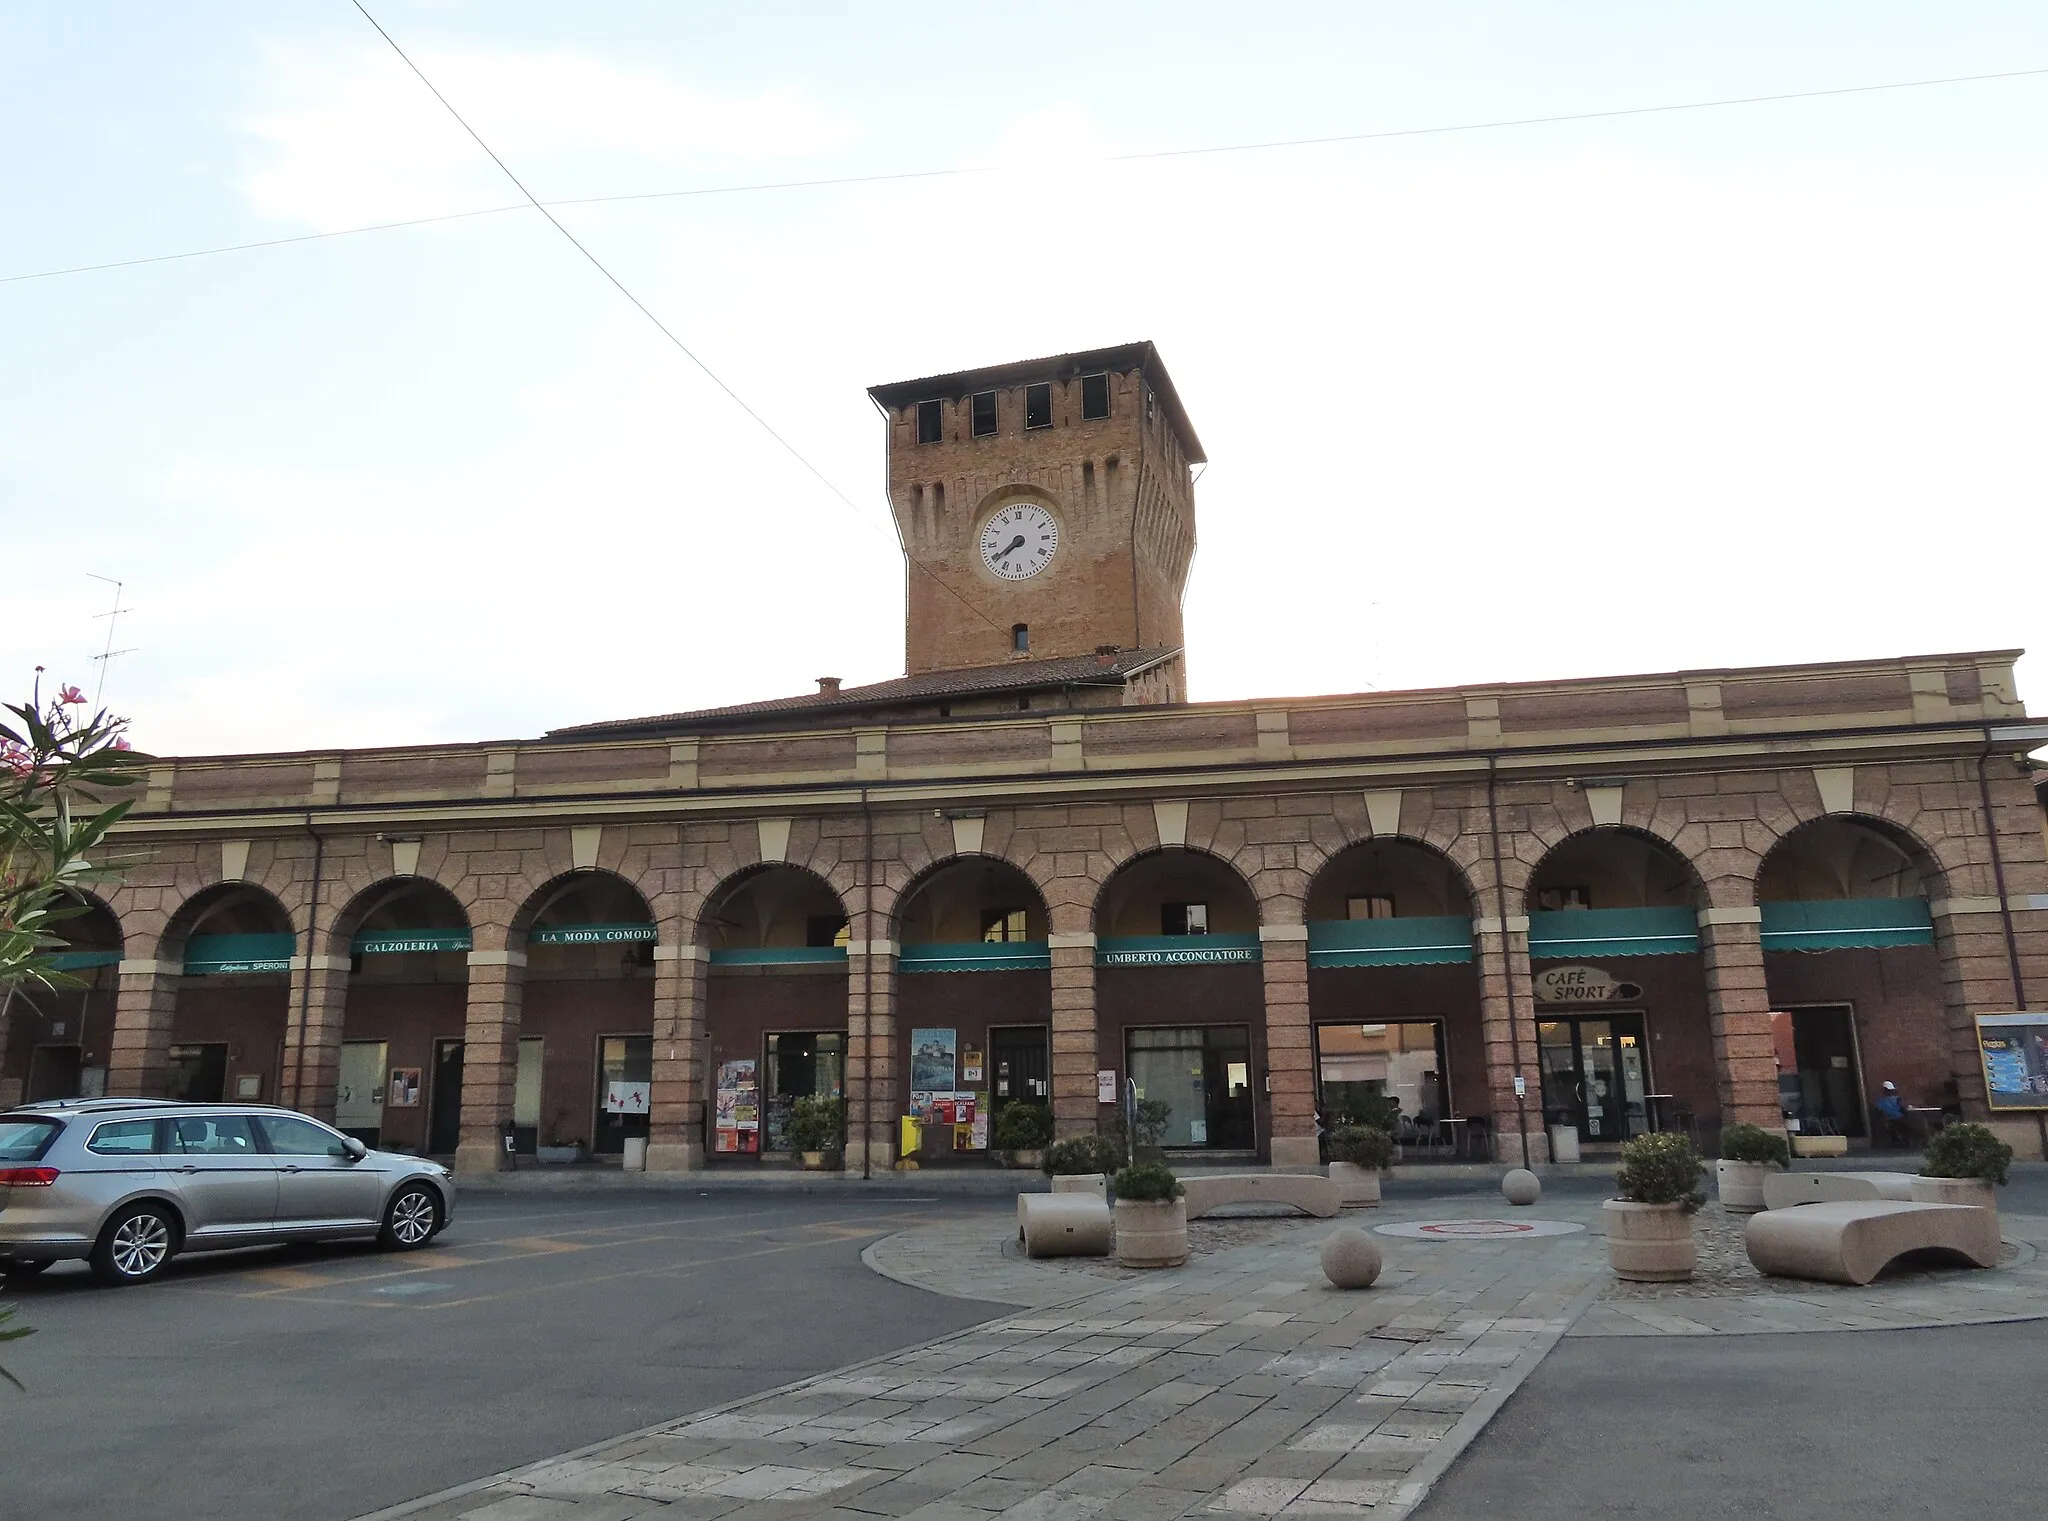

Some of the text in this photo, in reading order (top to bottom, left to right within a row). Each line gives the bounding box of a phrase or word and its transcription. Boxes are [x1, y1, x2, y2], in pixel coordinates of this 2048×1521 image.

[541, 933, 557, 942] LA
[564, 932, 600, 942] MODA
[365, 942, 439, 953] CALZOLERIA
[1106, 950, 1252, 964] UMBERTO ACCONCIATORE
[252, 962, 288, 970] SPERONI
[1545, 969, 1587, 986] CAFÉ
[1554, 985, 1606, 1000] SPORT
